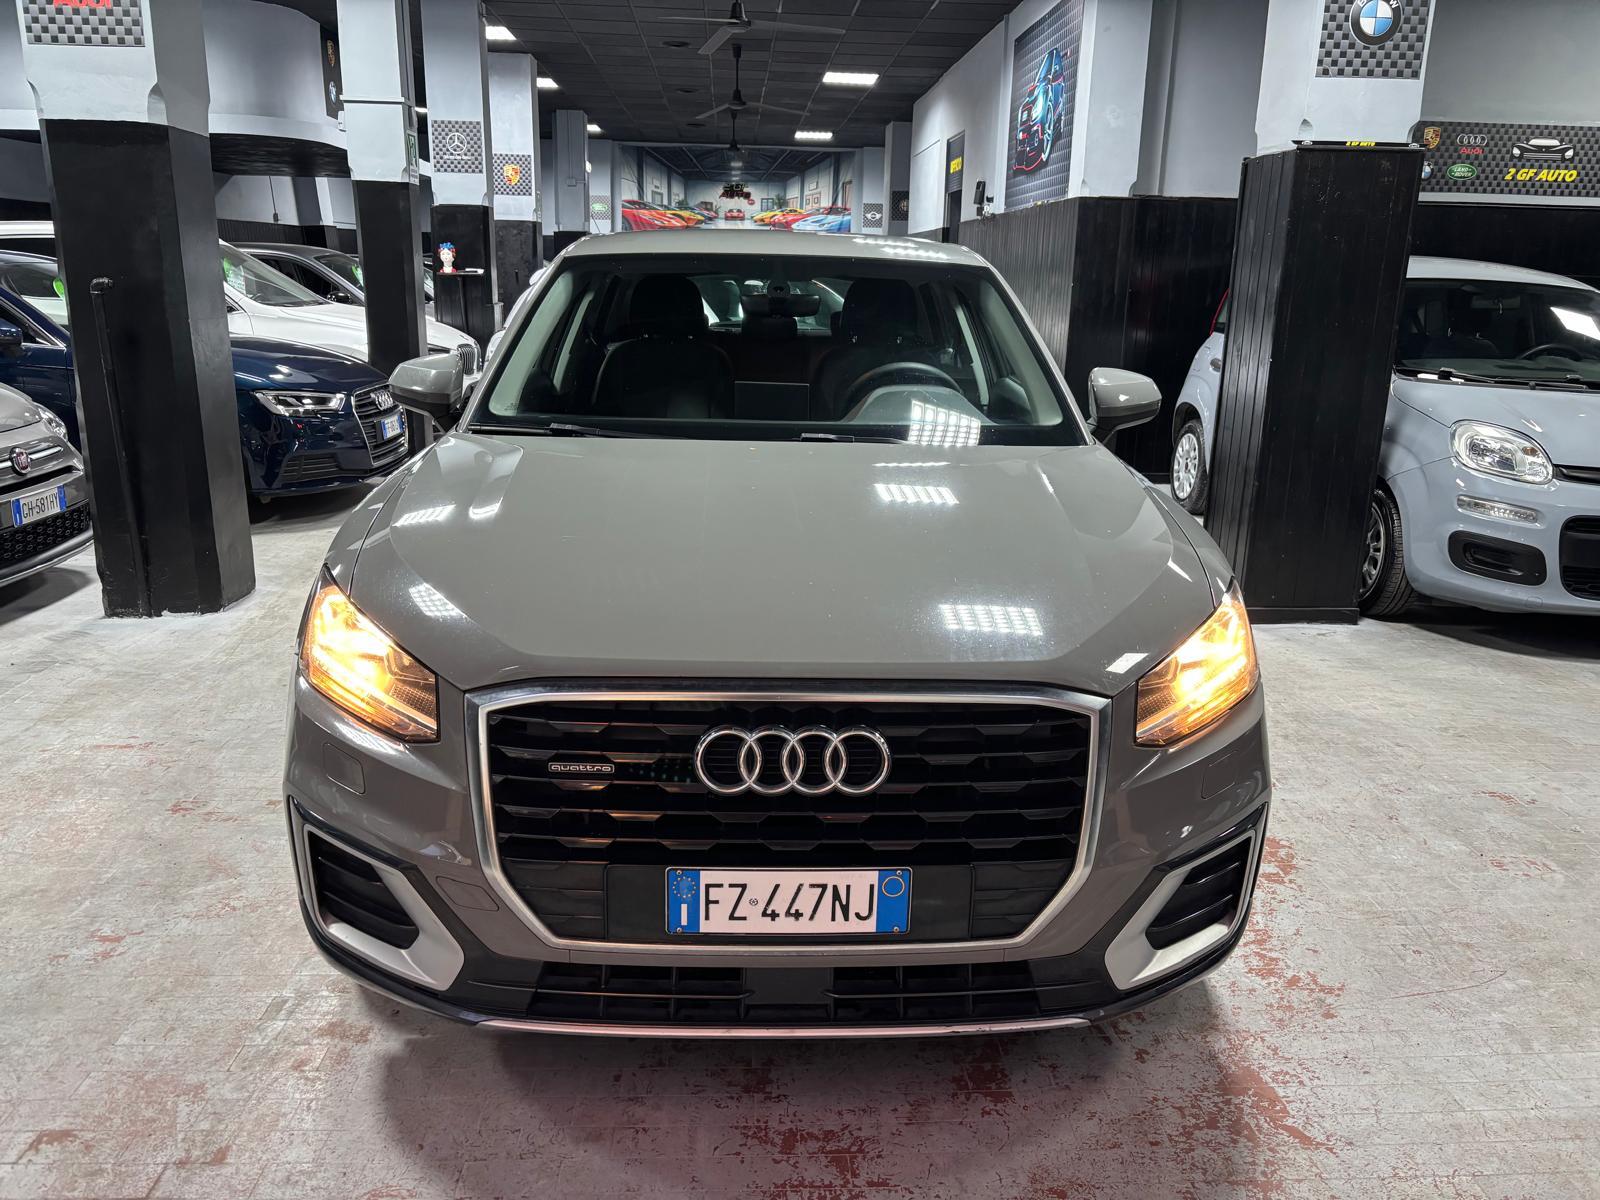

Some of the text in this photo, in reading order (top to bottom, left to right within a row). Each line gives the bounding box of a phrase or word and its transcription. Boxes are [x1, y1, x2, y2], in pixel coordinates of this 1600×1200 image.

[1504, 168, 1578, 182] 2 GF AUTO
[551, 764, 611, 772] quattro
